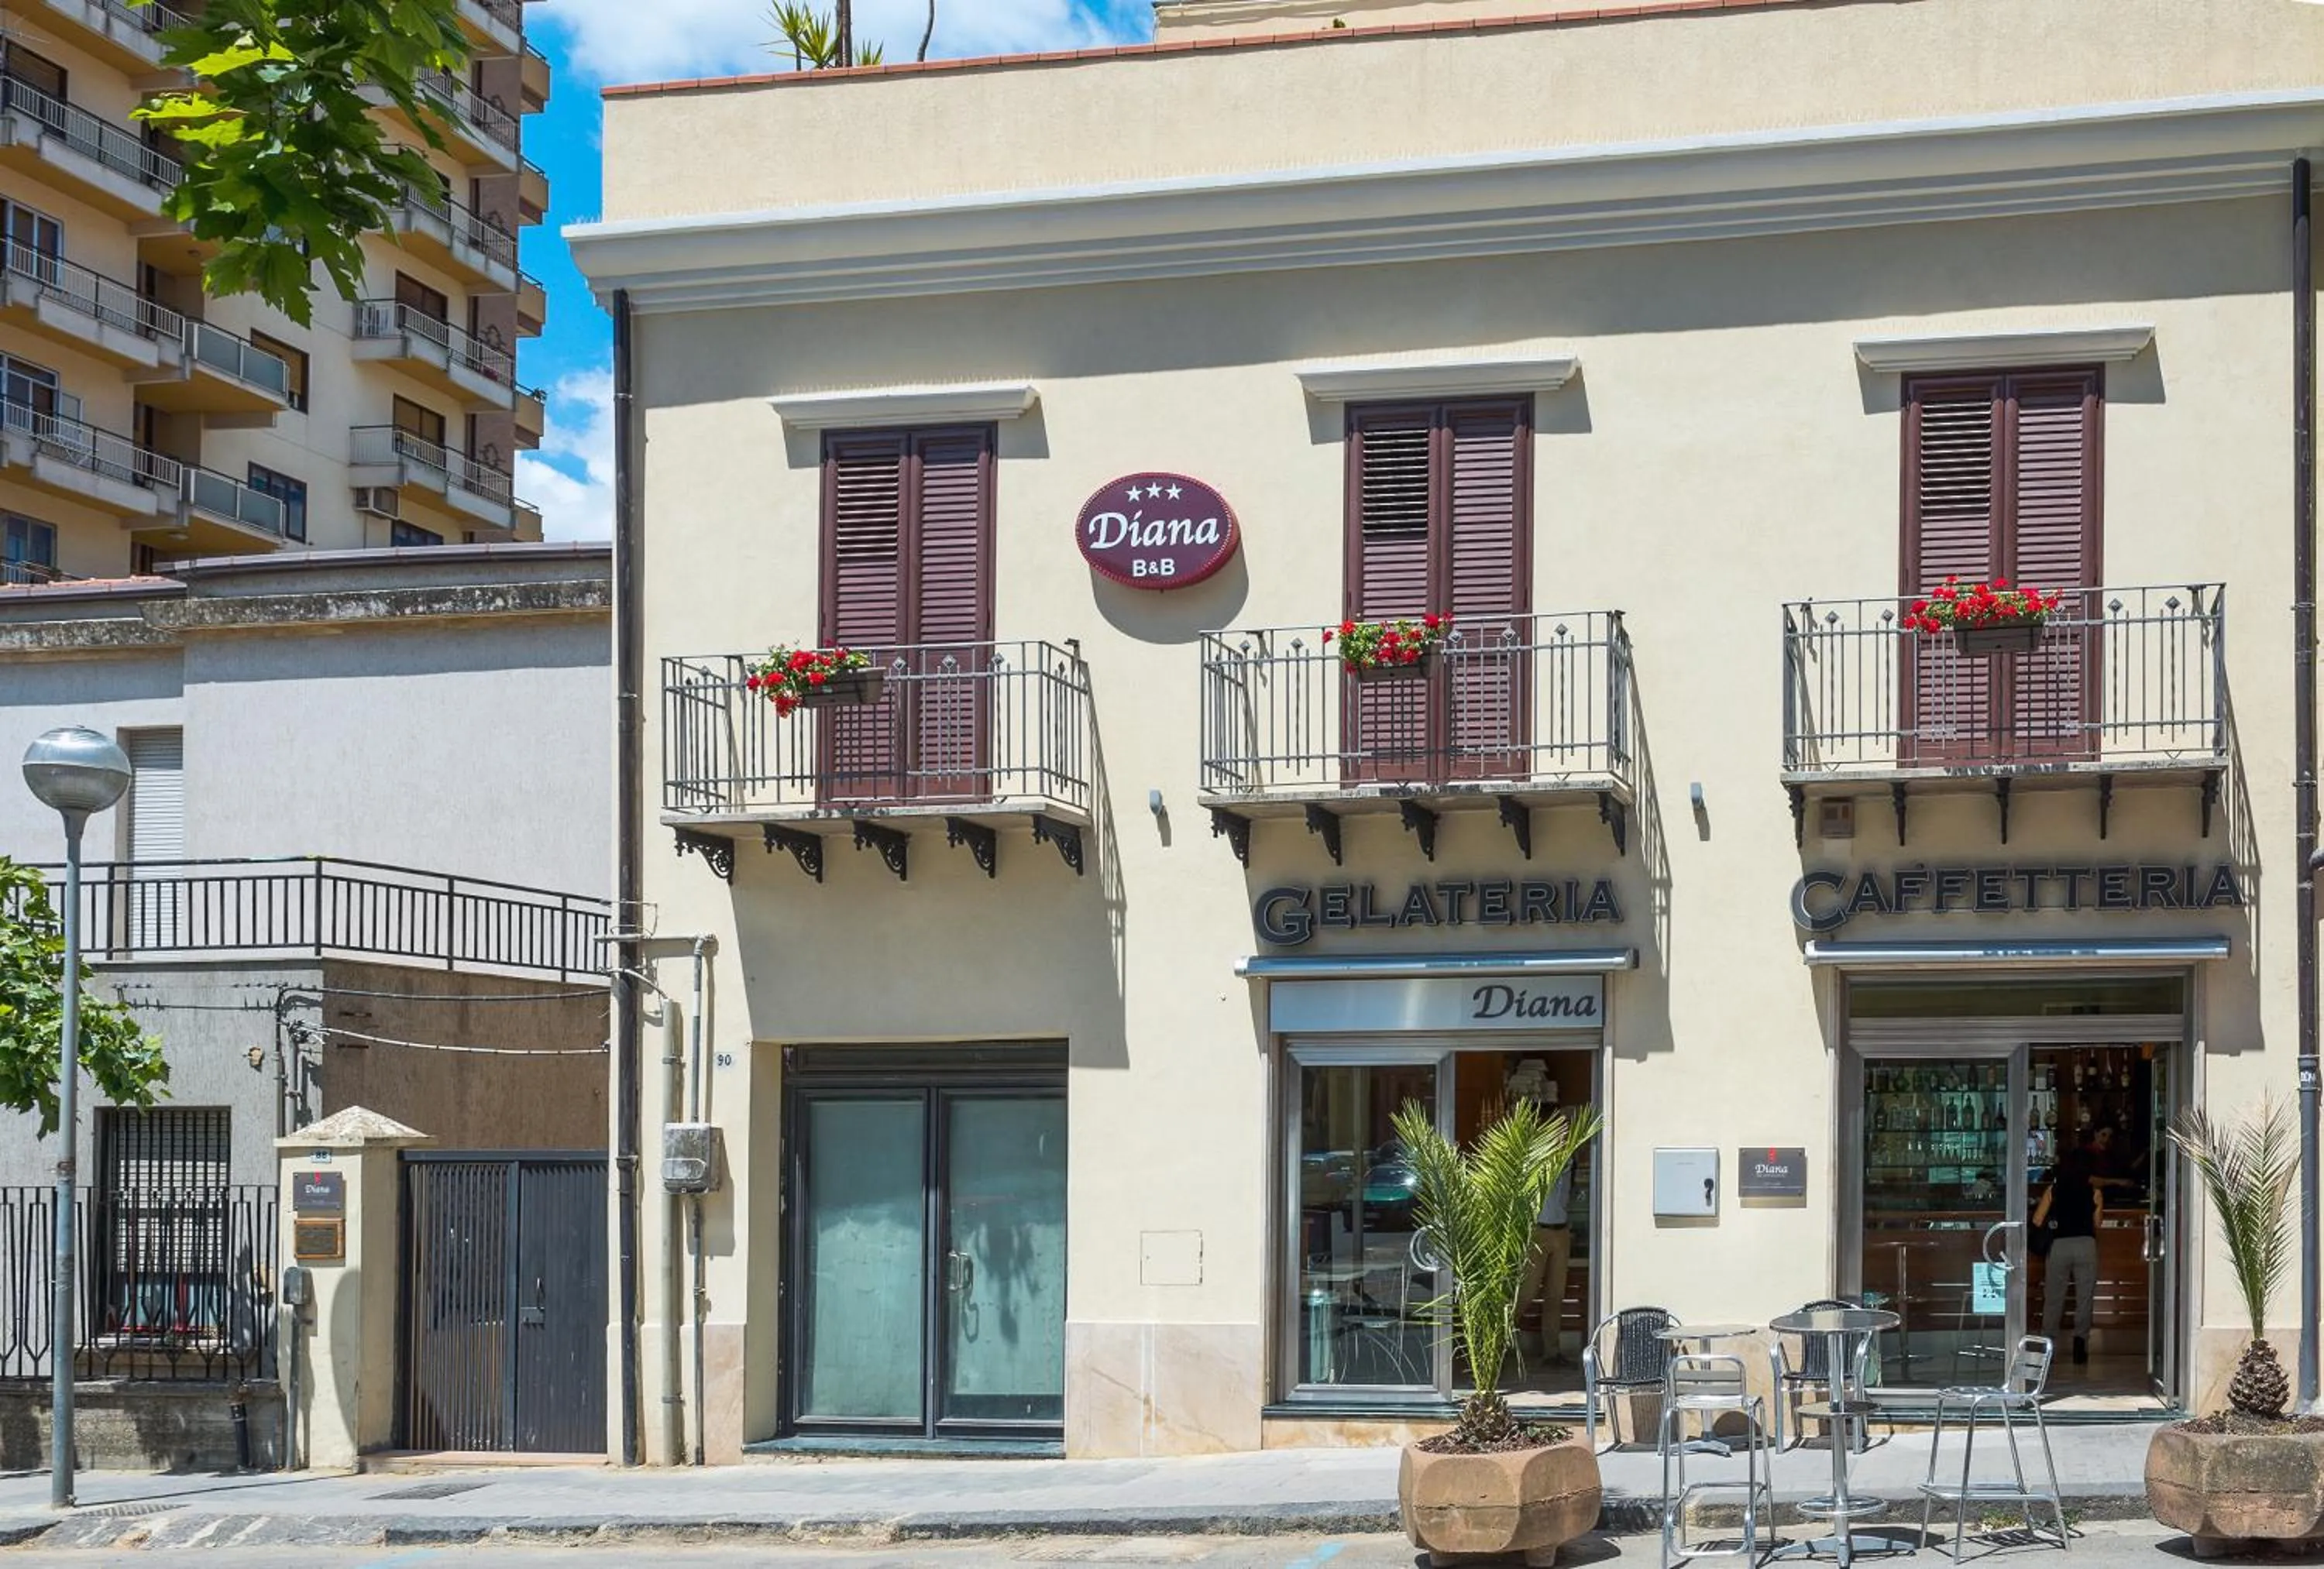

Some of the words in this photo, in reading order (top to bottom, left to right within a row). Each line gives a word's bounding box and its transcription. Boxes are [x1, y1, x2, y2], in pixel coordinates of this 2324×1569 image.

[1088, 510, 1220, 549] Diana
[1133, 558, 1175, 577] B&B
[1254, 878, 1624, 946] GELATERIA
[1790, 862, 2243, 932] CAFFETTERIA
[1472, 984, 1598, 1019] Diana
[717, 1054, 732, 1066] 90
[1755, 1164, 1789, 1173] Diana
